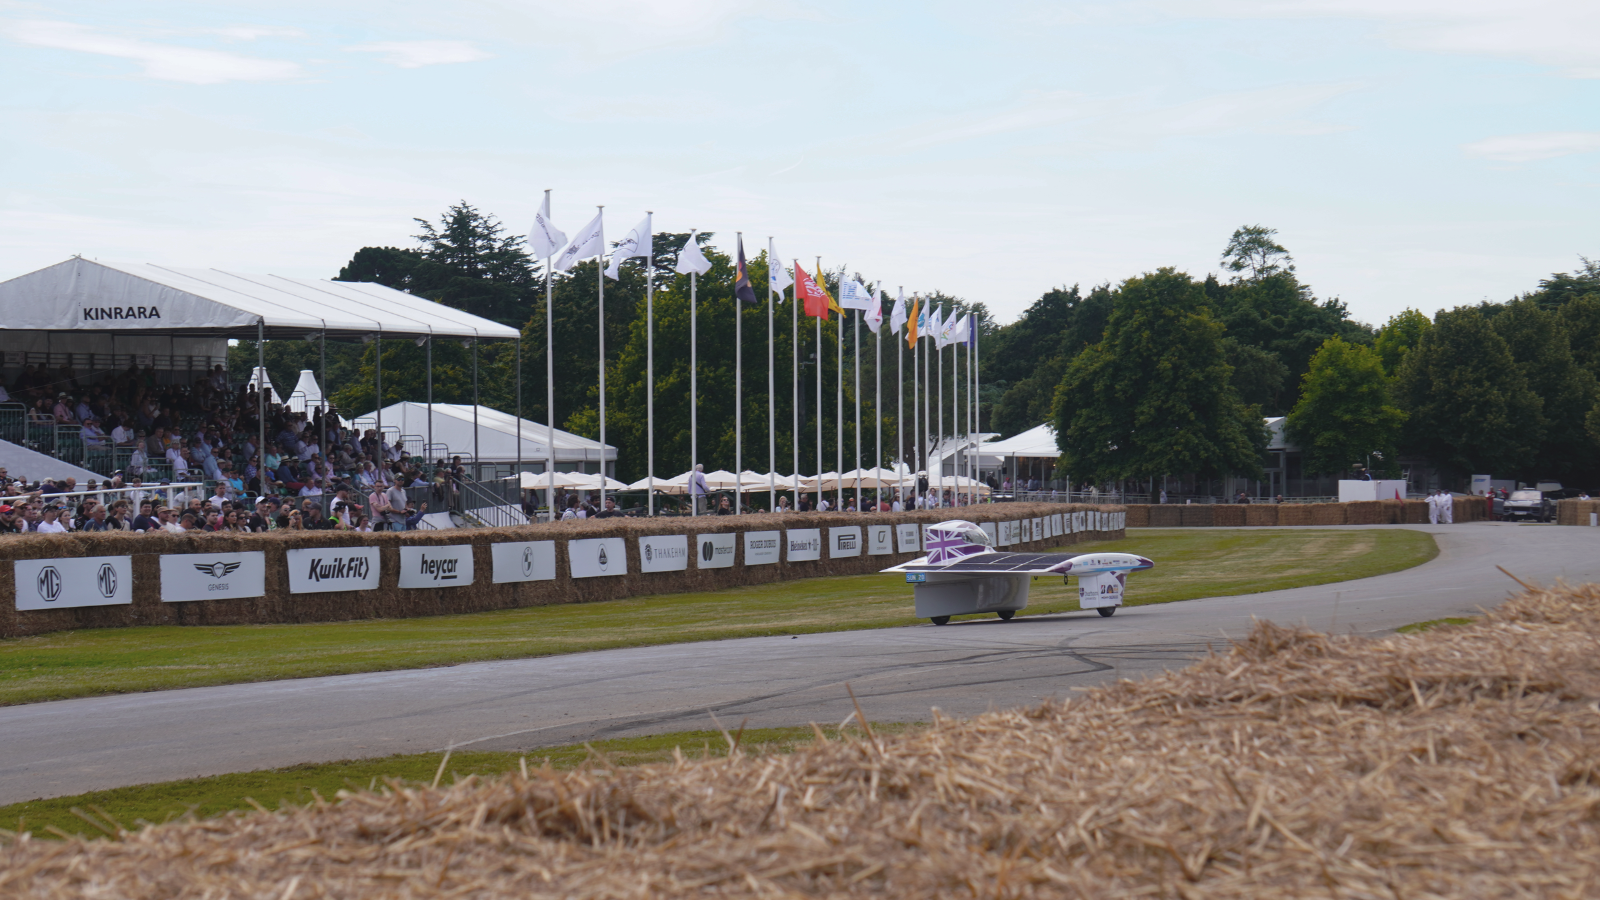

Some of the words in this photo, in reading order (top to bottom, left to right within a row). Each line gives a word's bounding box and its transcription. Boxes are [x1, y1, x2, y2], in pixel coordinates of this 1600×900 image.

[83, 306, 161, 321] KINRARA
[837, 534, 857, 551] PIRELLI
[653, 547, 686, 559] THAKEHAM
[420, 553, 459, 581] heycar
[40, 569, 60, 599] MG
[99, 566, 116, 595] MG
[207, 583, 230, 592] GENESIS
